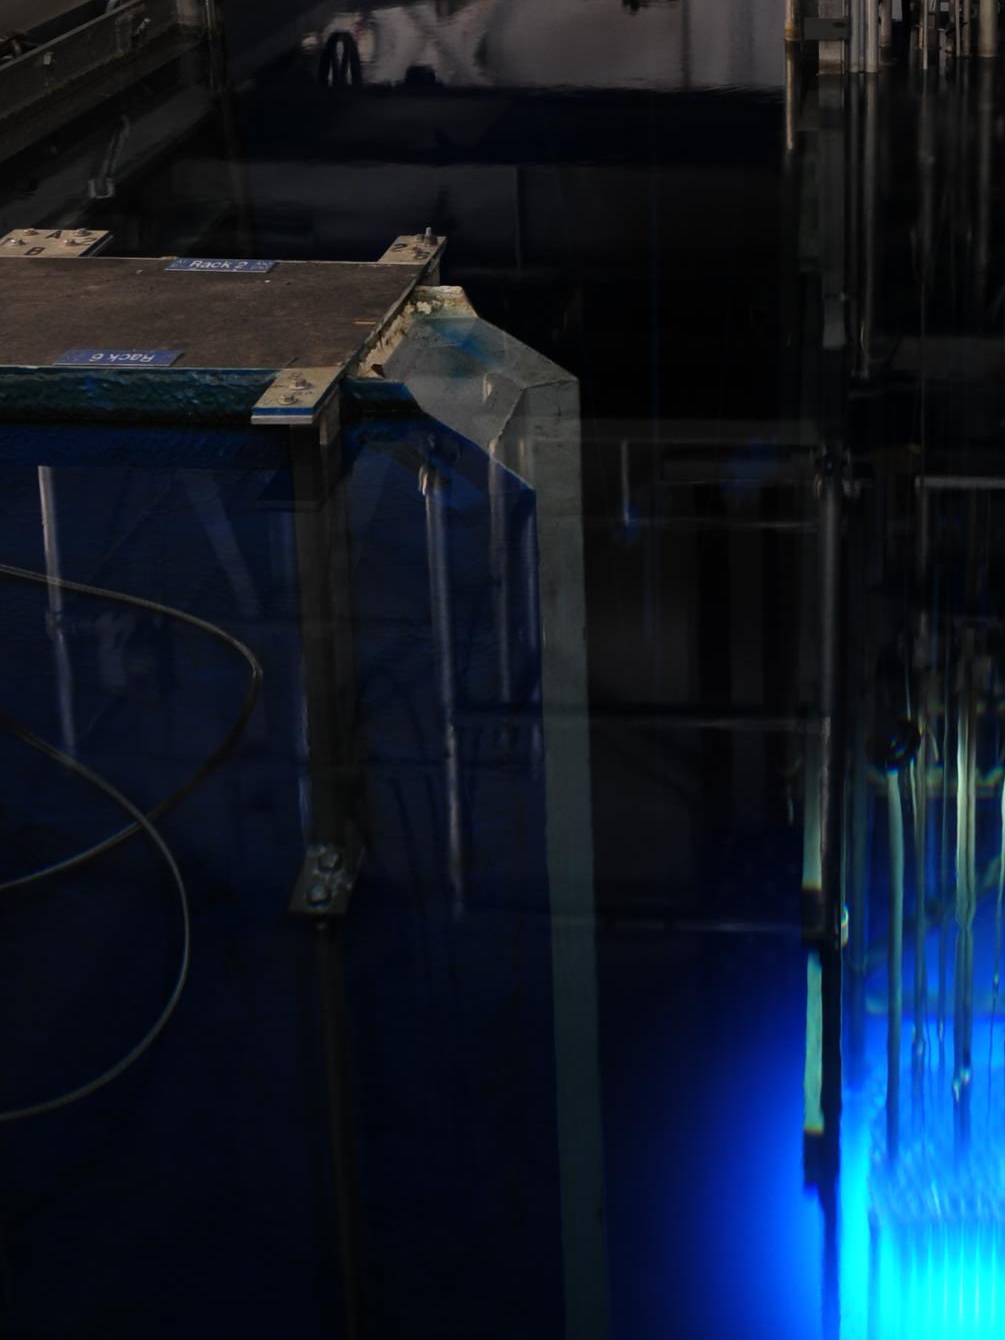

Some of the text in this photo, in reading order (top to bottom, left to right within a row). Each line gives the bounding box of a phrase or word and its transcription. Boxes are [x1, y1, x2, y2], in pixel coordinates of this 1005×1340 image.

[45, 230, 62, 239] A
[24, 247, 46, 256] B
[189, 260, 230, 269] Rack
[234, 261, 248, 269] 2
[109, 353, 154, 363] Rack
